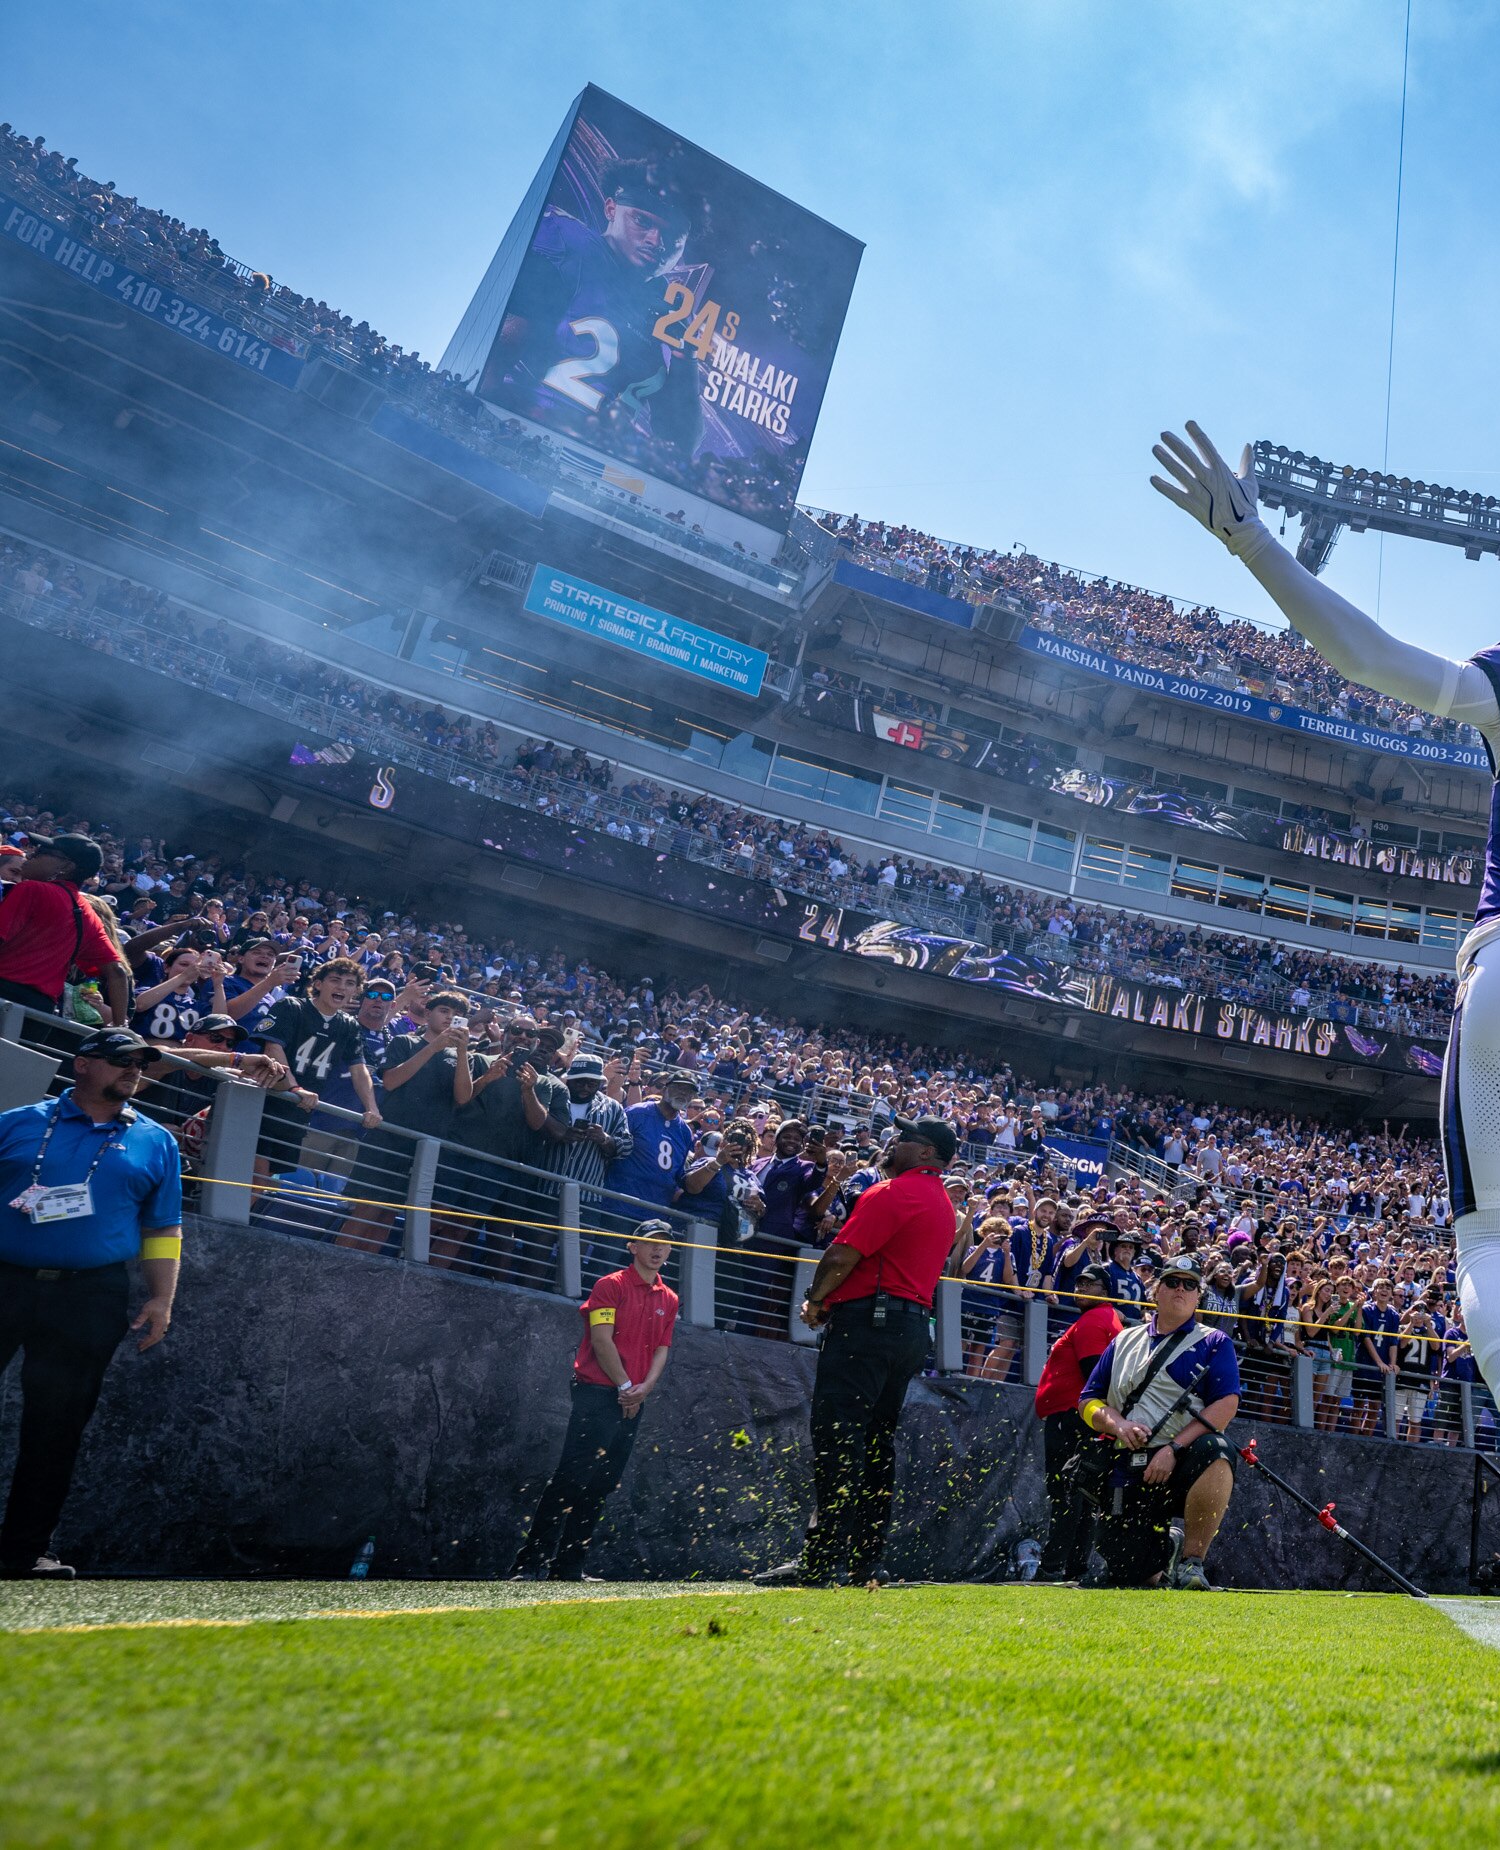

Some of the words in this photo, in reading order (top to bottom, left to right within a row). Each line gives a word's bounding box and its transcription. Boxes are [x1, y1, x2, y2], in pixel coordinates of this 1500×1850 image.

[4, 206, 54, 253] FOR
[54, 237, 115, 284] HELP
[117, 275, 271, 371] 410-324-6141
[652, 283, 721, 361] 24
[713, 340, 798, 405] MALAKI
[704, 371, 791, 435] STARKS
[544, 597, 587, 623] PRINTING
[598, 618, 637, 642] SIGNAGE
[646, 636, 691, 662] BRANDING
[700, 658, 749, 684] MARKETING
[550, 579, 657, 630] STRATEGIC
[671, 626, 754, 667] FACTORY
[1036, 637, 1109, 673] MARSHAL
[1113, 664, 1165, 691] YANDA
[1170, 681, 1252, 712] 2007-2019
[1299, 715, 1358, 742] TERRELL
[1362, 732, 1408, 753] SUGGS
[1411, 743, 1489, 767] 2003-2018
[678, 806, 688, 816] 22
[1374, 822, 1389, 832] 430
[1382, 845, 1473, 885] STARKS
[799, 904, 844, 947] 24
[328, 945, 337, 959] 8
[1085, 975, 1206, 1033] MALAKI
[1217, 1002, 1334, 1057] STARKS
[295, 1036, 336, 1079] 44
[1031, 1129, 1038, 1141] 8
[658, 1140, 672, 1171] 8
[1062, 1156, 1104, 1176] MGM
[1331, 1186, 1341, 1197] 21
[1360, 1196, 1366, 1207] 2
[979, 1262, 994, 1281] 4
[1206, 1302, 1239, 1316] RAVENS
[1374, 1324, 1385, 1347] 4
[1405, 1338, 1427, 1365] 21
